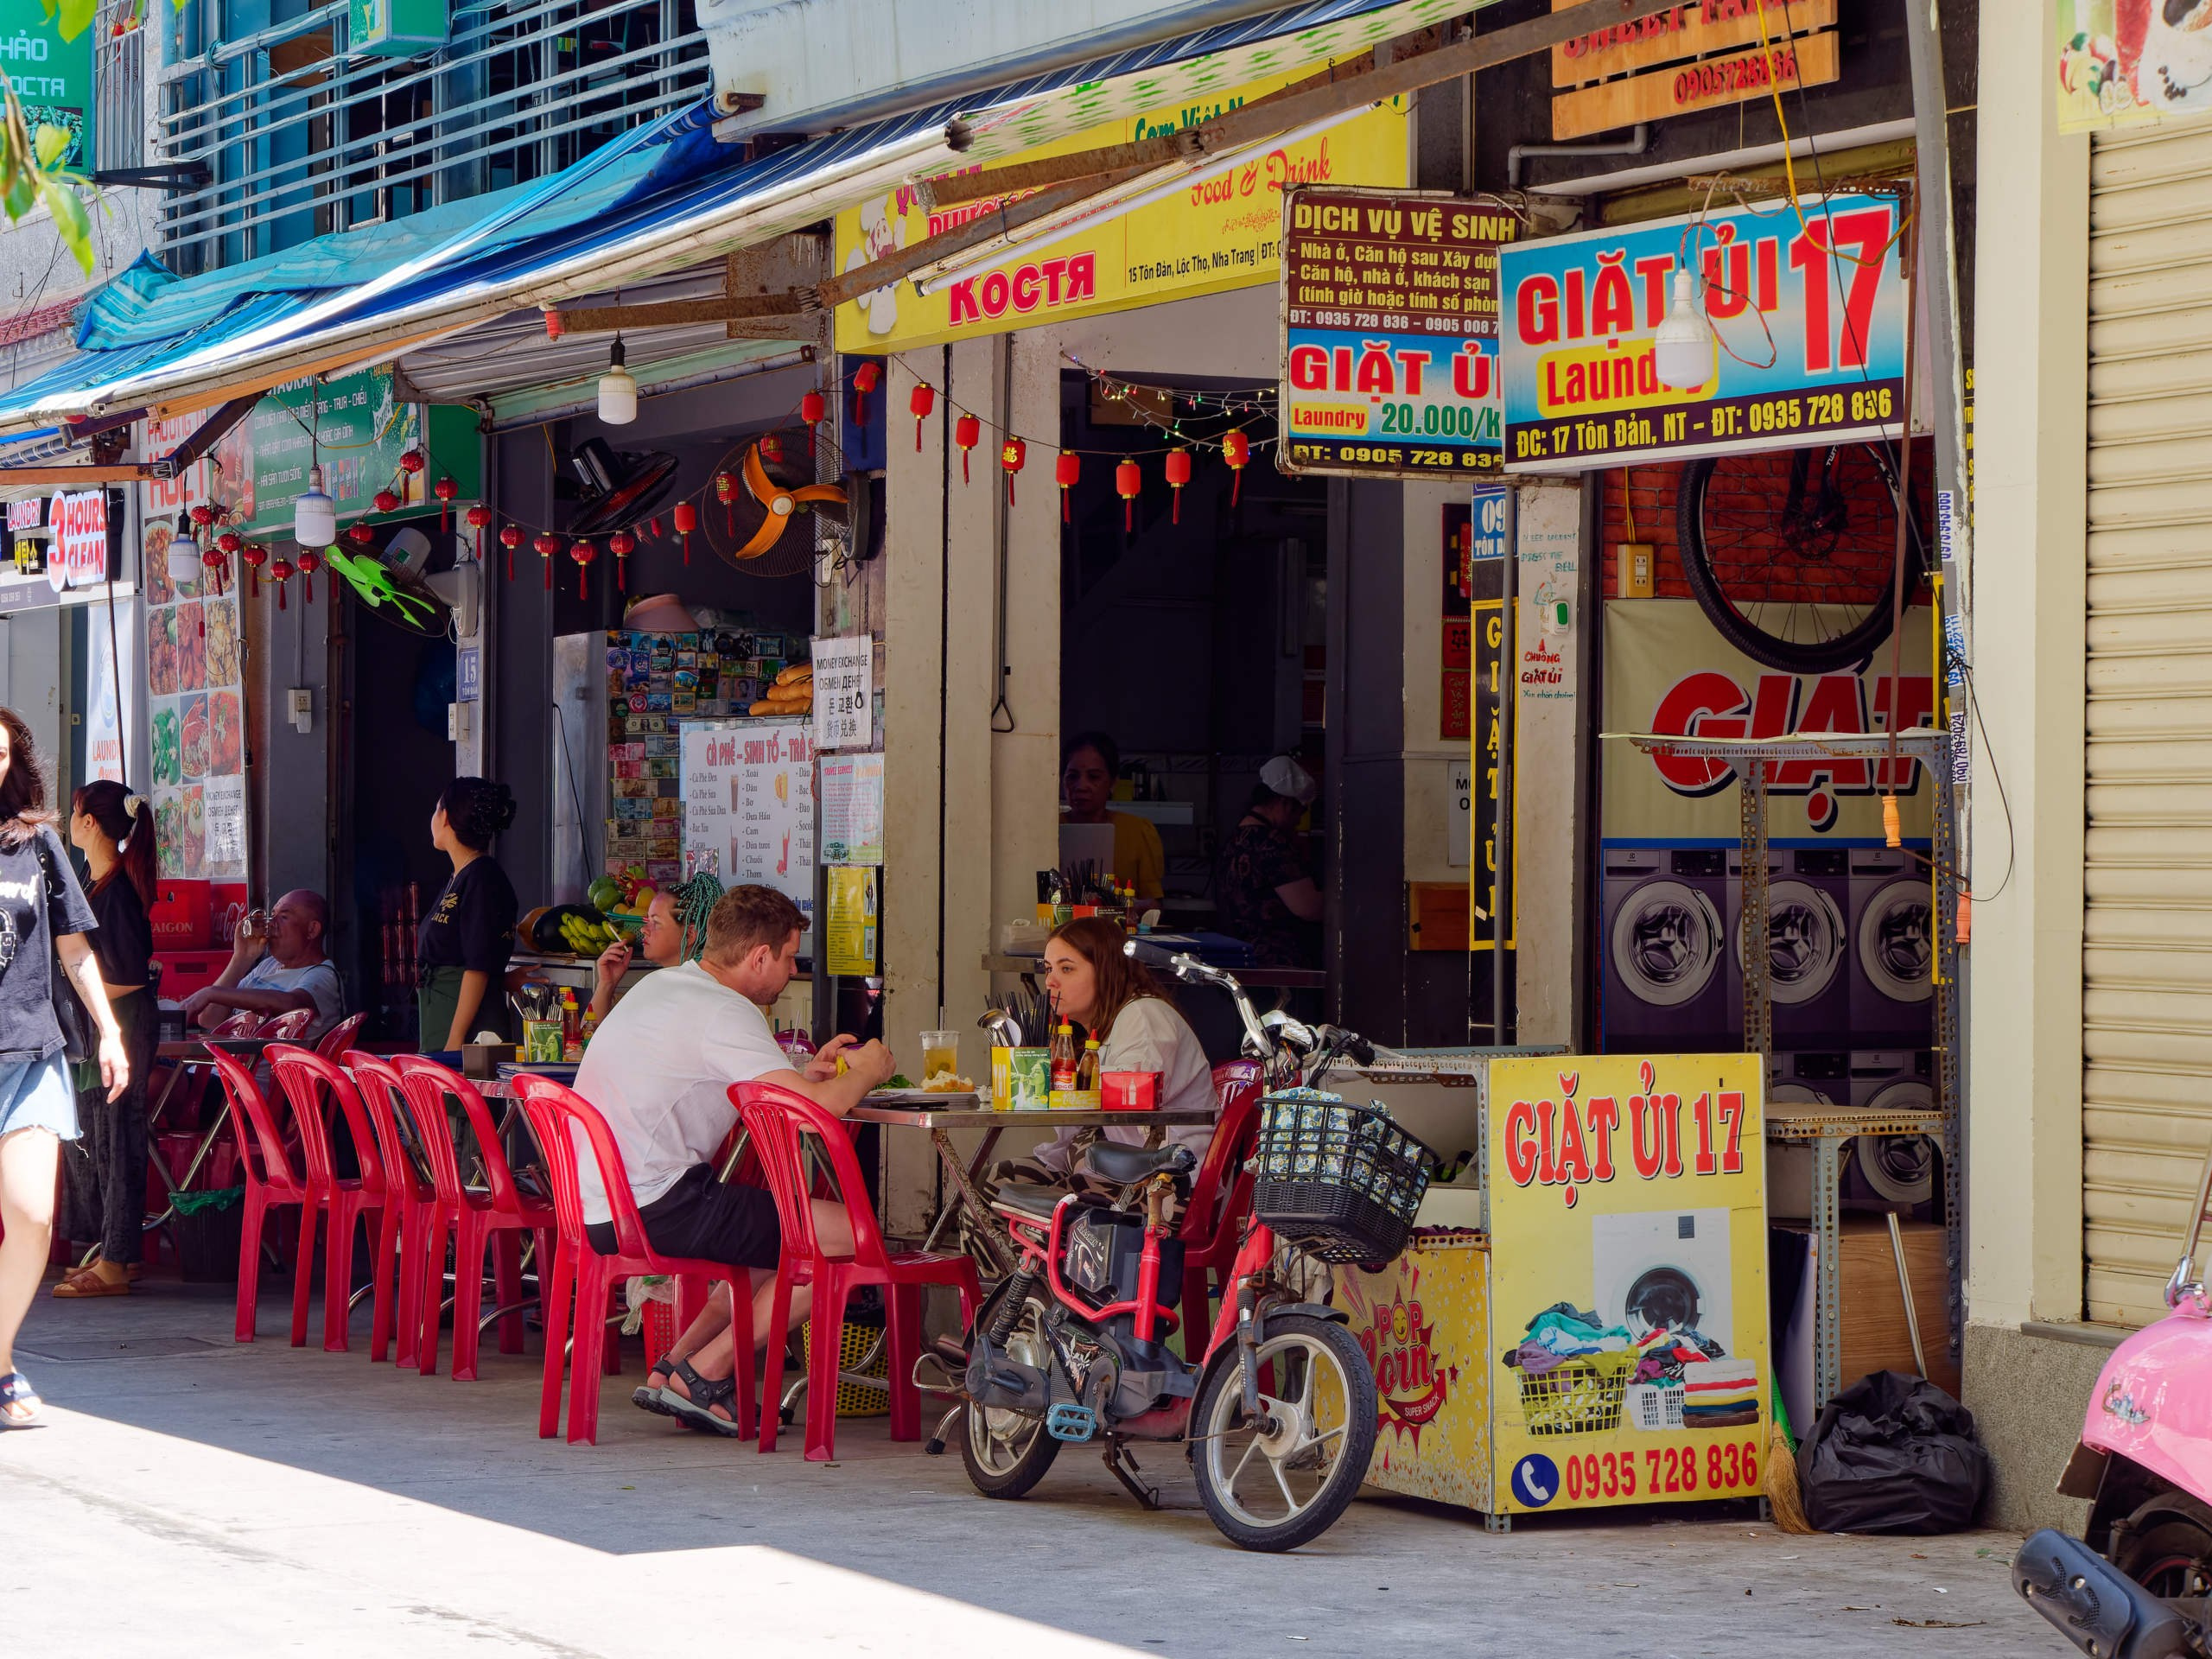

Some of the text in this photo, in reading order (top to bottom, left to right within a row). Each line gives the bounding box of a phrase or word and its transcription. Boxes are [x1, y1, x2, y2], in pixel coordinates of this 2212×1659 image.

[1267, 143, 1332, 193] Drink
[1294, 204, 1516, 243] DỊCH VỤ VỆ SINH
[1128, 267, 1137, 283] 15
[1139, 263, 1154, 281] Tôn
[1176, 254, 1190, 276] Lộc
[1212, 250, 1229, 269] Nha
[1231, 247, 1255, 266] Trang
[1300, 242, 1332, 260] Nhà
[1354, 245, 1384, 264] Căn
[1388, 248, 1407, 268] hộ
[1411, 251, 1438, 266] sau
[1443, 251, 1471, 270] Xây
[949, 251, 1096, 326] КОСТЯ
[1300, 264, 1330, 282] Căn
[1334, 266, 1357, 287] hộ,
[1363, 268, 1391, 285] nhà
[1414, 273, 1459, 289] khách
[1464, 276, 1491, 294] sạn
[1517, 205, 1892, 376] GIẶT ỦI 17
[1299, 285, 1334, 303] (tính
[1339, 288, 1363, 306] giờ
[1367, 289, 1405, 310] hoặc
[1408, 291, 1438, 309] tính
[1441, 292, 1460, 311] số
[1290, 309, 1312, 324] ĐT:
[1315, 310, 1351, 326] 0935
[1354, 313, 1379, 327] 728
[1382, 315, 1409, 329] 836
[1425, 317, 1459, 333] 0905
[1290, 341, 1431, 404] GIẶT
[1294, 408, 1365, 429] Laundry
[1516, 388, 1892, 458] ĐC: 17 Tôn Đản, NT ĐT: 0935 728 836
[1340, 448, 1402, 464] 0905
[1410, 450, 1453, 466] 728
[7, 498, 41, 531] LAUNDRY
[48, 494, 107, 585] 3 HOURS CLEAN
[1475, 536, 1495, 557] TÔN
[464, 656, 477, 683] 15
[817, 655, 868, 671] MONEY EXCHANGE
[819, 676, 841, 690] ОБМЕН
[707, 729, 806, 766] CÀ PHÊ SINH TỐ TRÀ
[746, 827, 759, 836] Cam
[151, 921, 194, 934] AIGON
[1503, 1059, 1745, 1208] GIẶT ỦI 17
[1377, 1300, 1424, 1346] POP
[1404, 1392, 1440, 1417] SUPER SNACK
[1566, 1441, 1758, 1501] 0935 728 836
